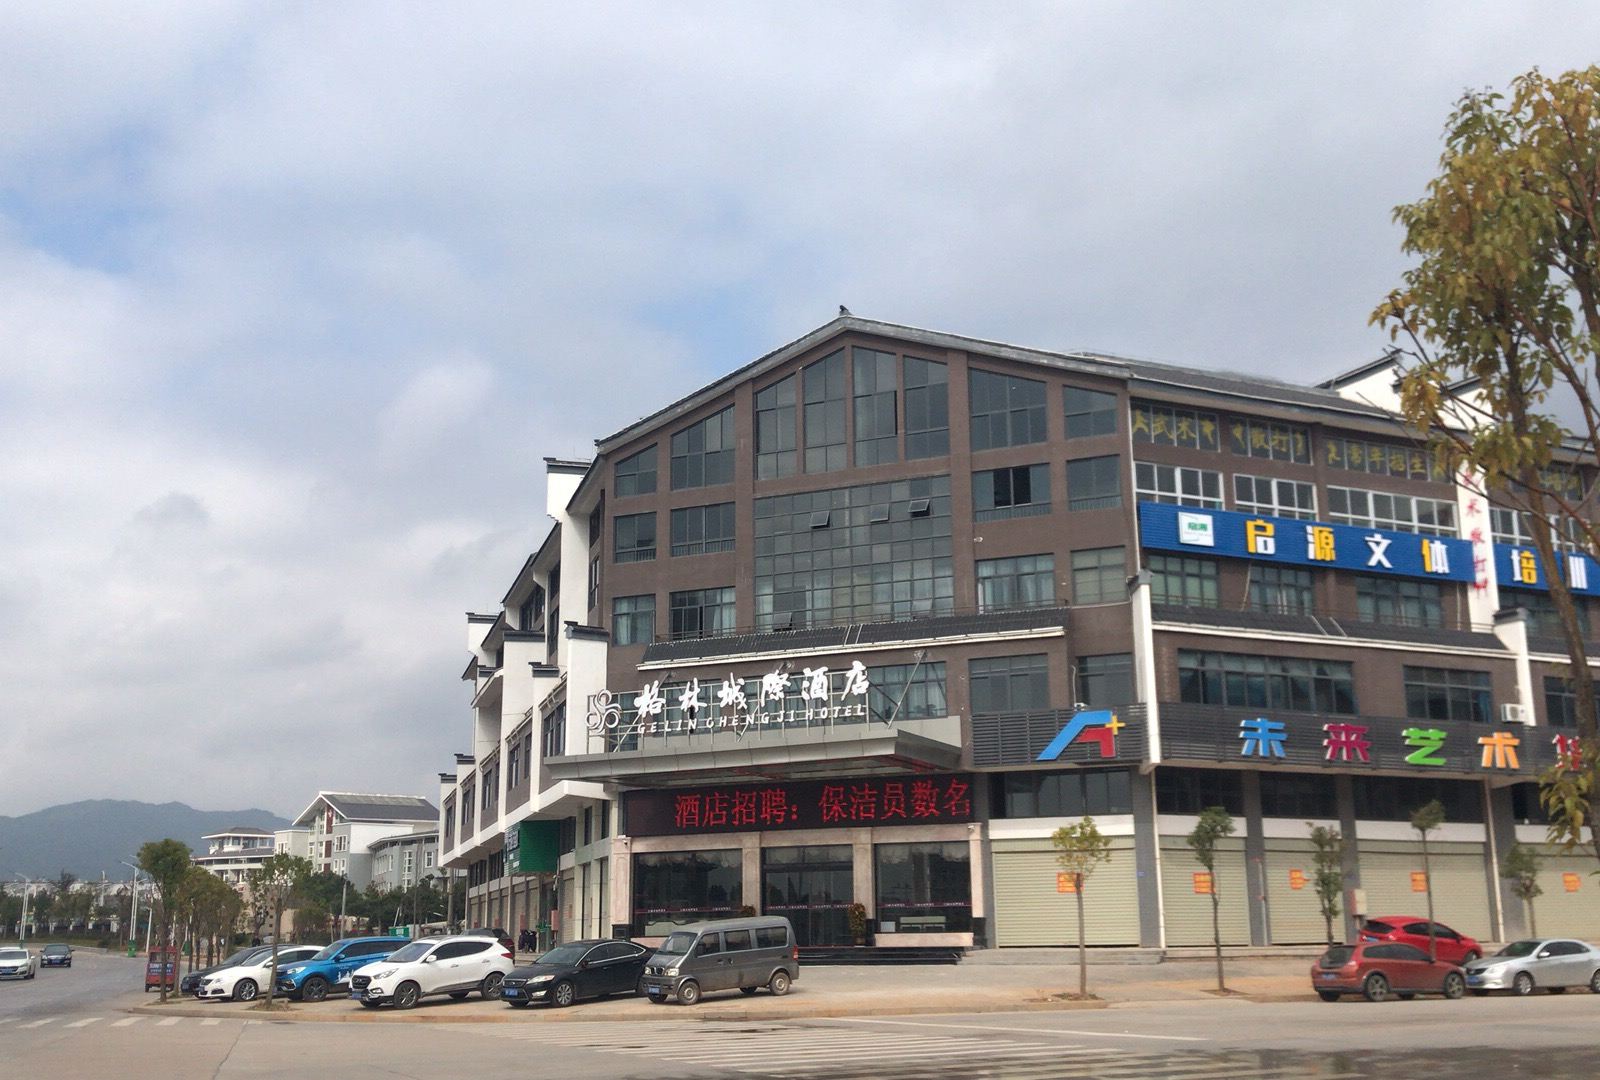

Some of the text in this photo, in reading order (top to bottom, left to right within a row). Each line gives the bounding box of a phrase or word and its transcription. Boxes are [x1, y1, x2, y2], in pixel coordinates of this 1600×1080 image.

[637, 703, 866, 734] GELIN CHENGJI HOTEL
[818, 778, 971, 822] 保洁员数名
